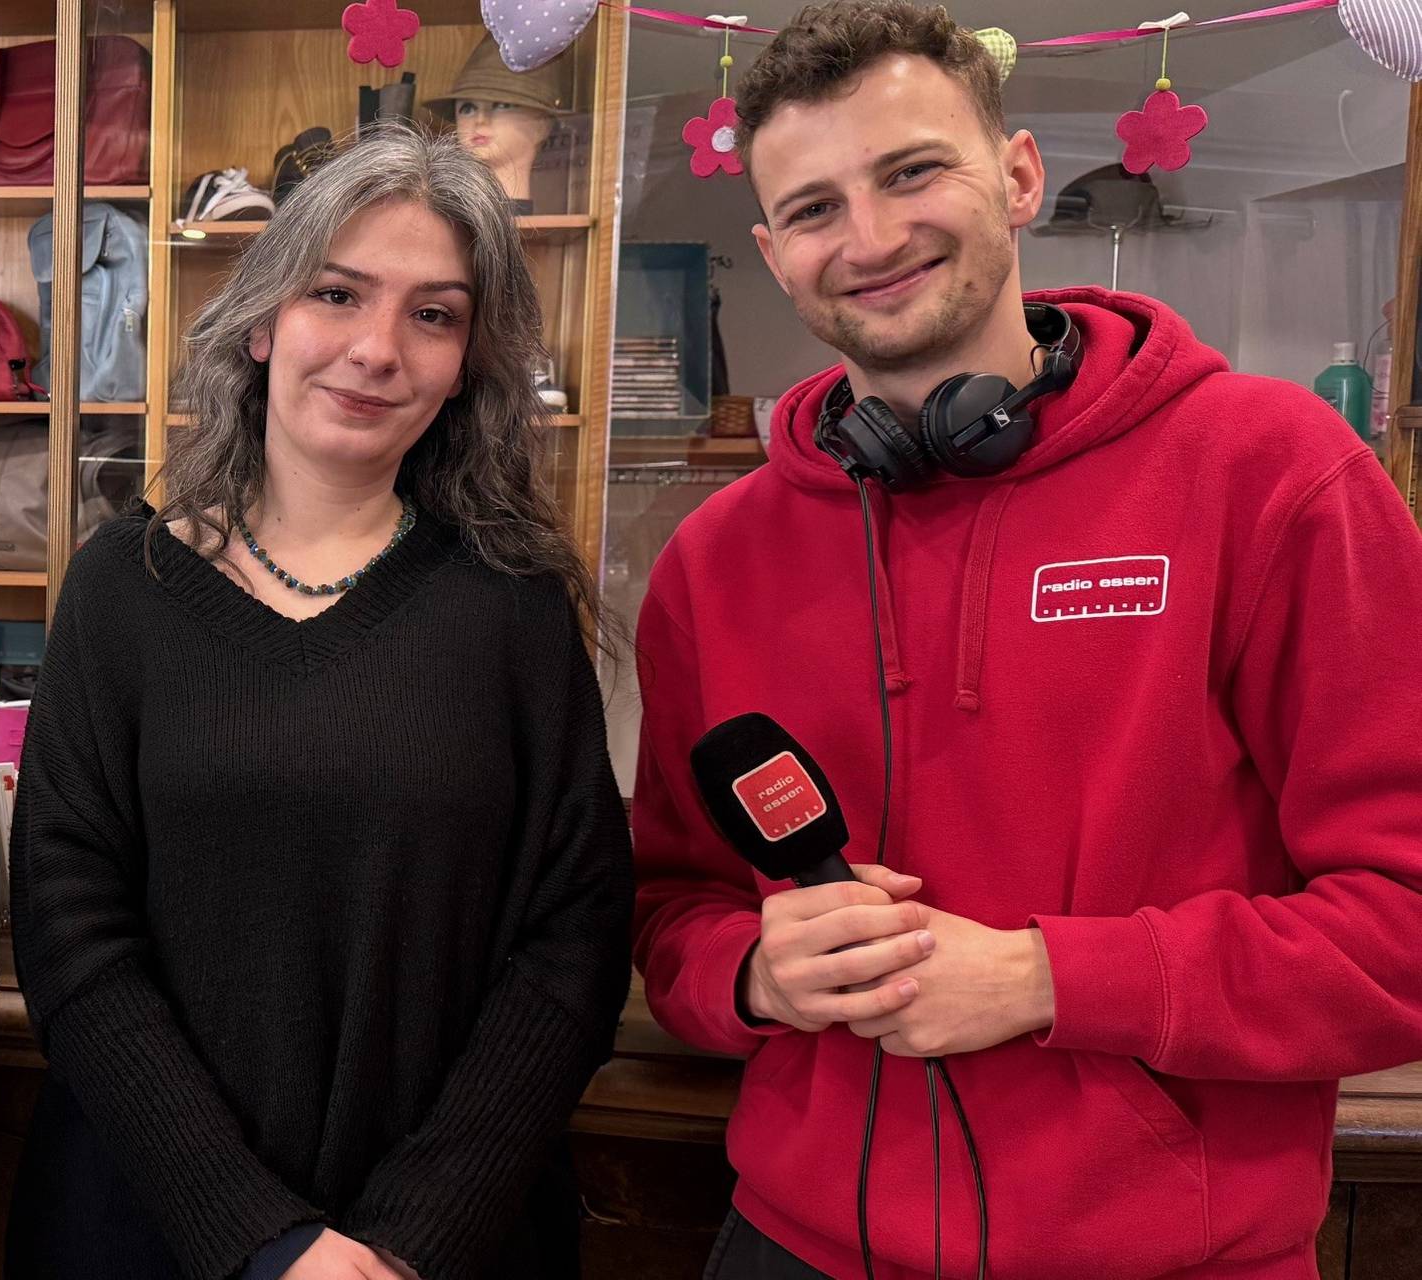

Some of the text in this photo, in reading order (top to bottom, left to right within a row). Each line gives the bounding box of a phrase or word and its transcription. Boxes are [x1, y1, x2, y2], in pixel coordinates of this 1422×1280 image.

[1042, 576, 1159, 594] radio essen
[758, 775, 795, 800] radio
[763, 785, 804, 813] essen
